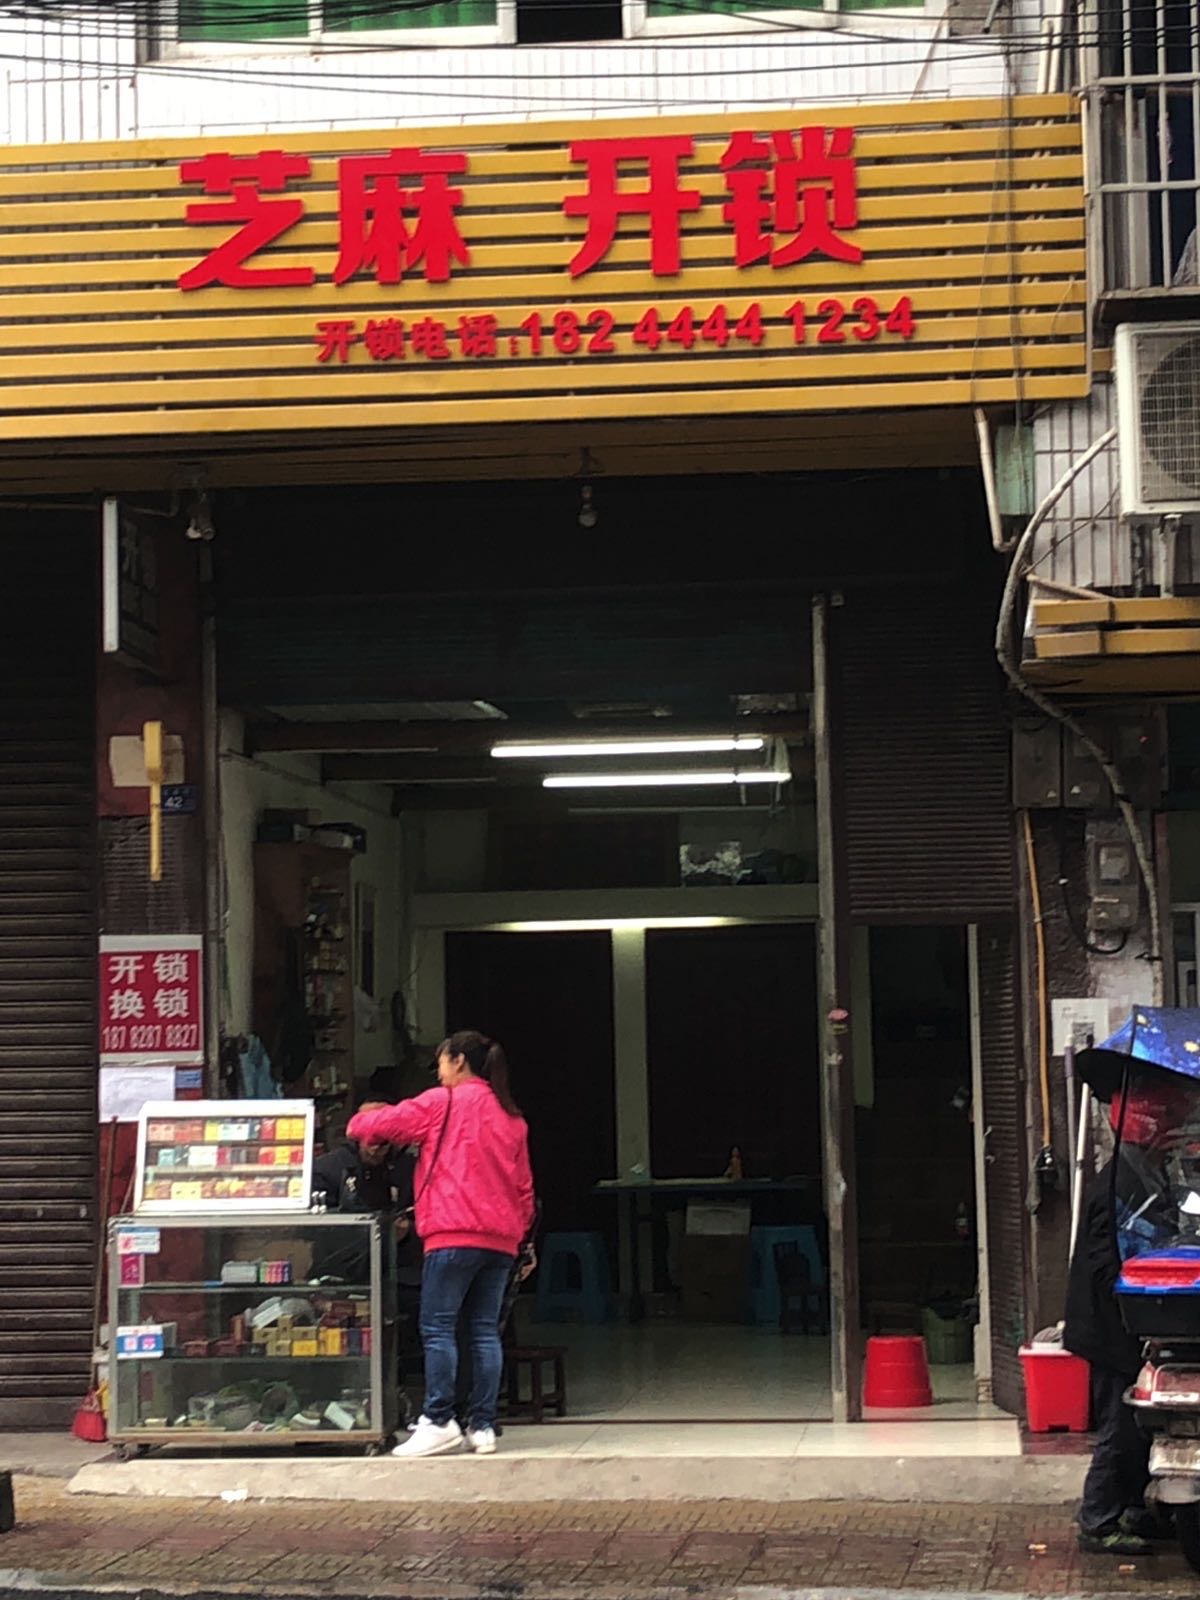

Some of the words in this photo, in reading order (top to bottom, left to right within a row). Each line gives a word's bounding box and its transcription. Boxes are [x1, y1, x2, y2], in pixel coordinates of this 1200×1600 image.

[177, 147, 472, 291] 芝麻
[562, 126, 865, 279] 开锁
[632, 303, 766, 351] 4444
[784, 296, 917, 344] 1234
